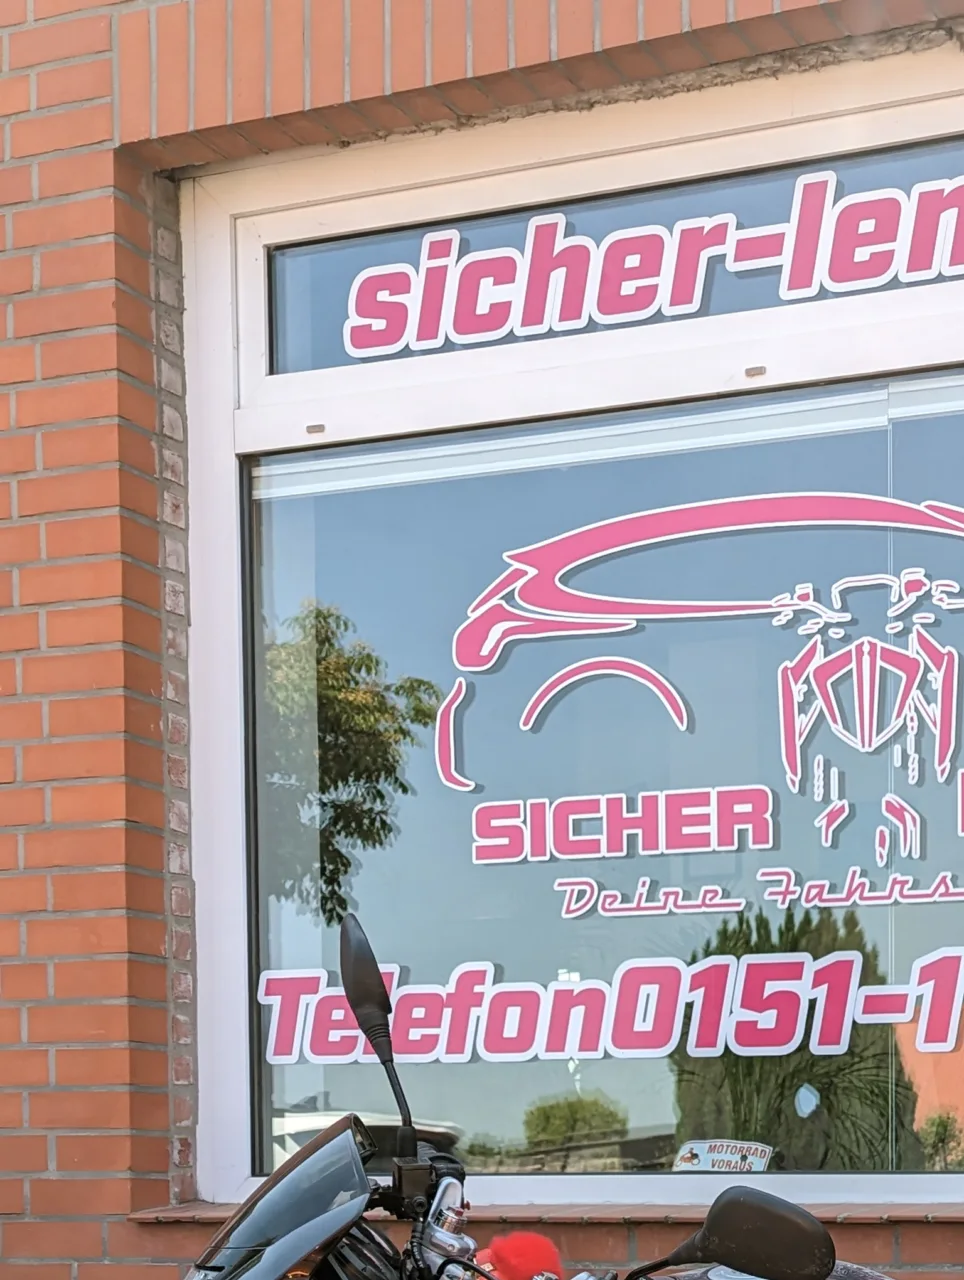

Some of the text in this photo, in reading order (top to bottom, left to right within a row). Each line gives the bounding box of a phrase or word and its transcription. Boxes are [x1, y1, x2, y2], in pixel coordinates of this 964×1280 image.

[473, 786, 771, 862] SICHER
[554, 877, 745, 917] Deine
[706, 1143, 767, 1160] MOTORRAD
[711, 1158, 754, 1172] VORAUS
